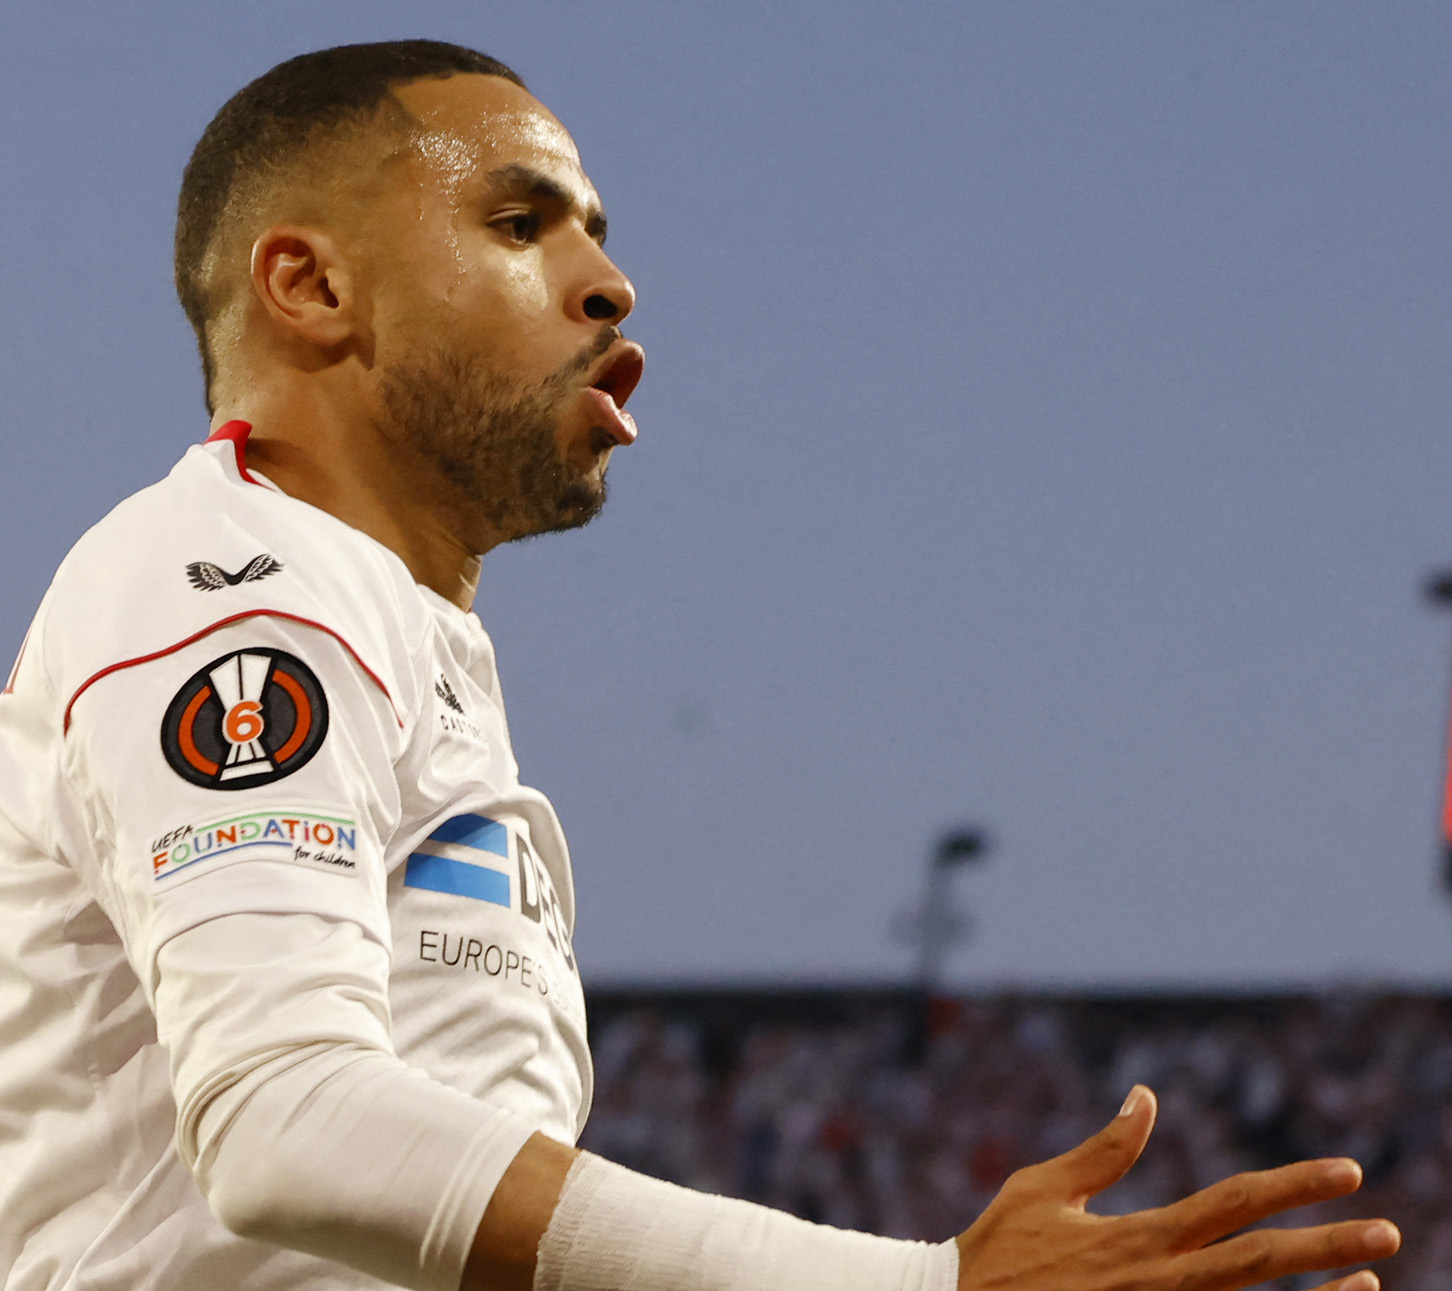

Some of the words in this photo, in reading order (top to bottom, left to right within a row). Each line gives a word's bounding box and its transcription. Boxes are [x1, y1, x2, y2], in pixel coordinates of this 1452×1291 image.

[225, 700, 264, 743] 6
[151, 824, 193, 853] UEFA
[293, 845, 311, 862] for
[313, 850, 356, 870] children
[419, 929, 548, 997] EUROPE'S
